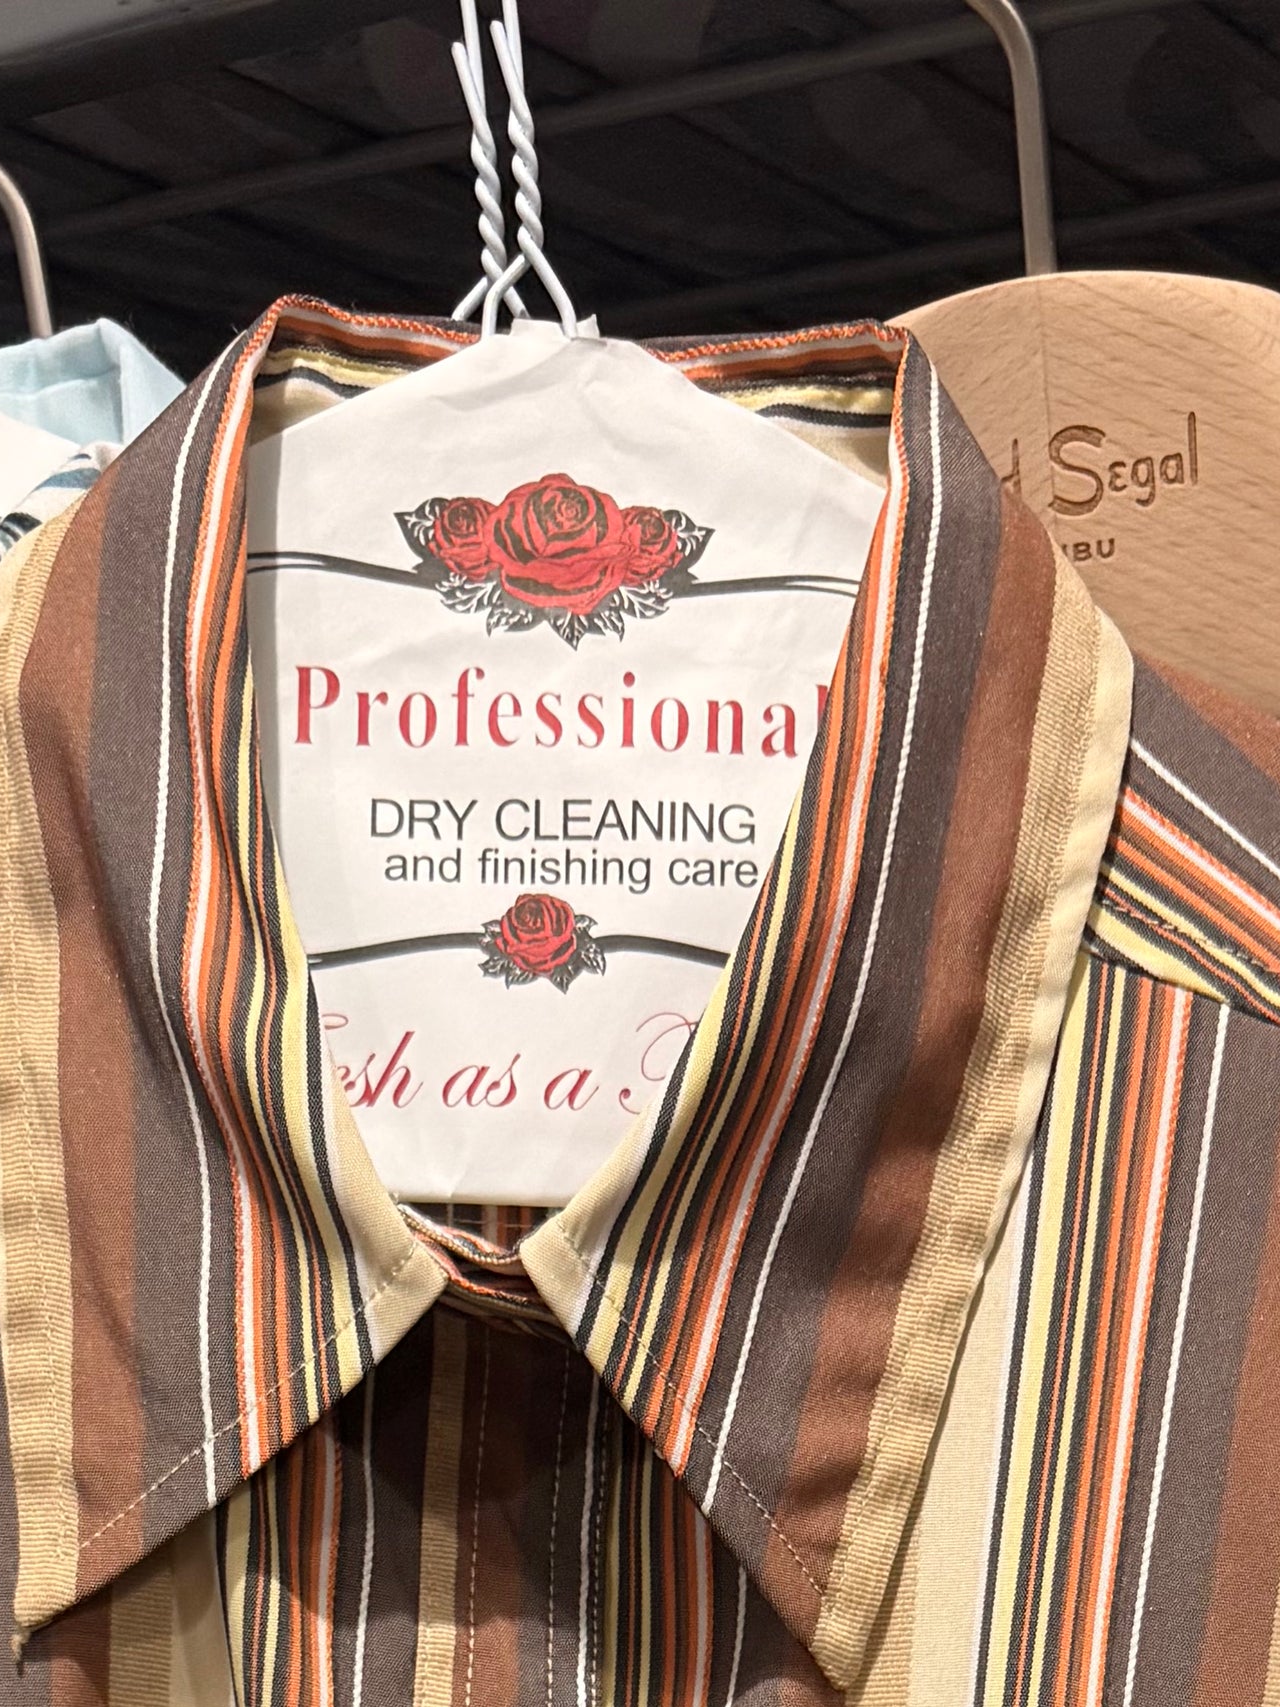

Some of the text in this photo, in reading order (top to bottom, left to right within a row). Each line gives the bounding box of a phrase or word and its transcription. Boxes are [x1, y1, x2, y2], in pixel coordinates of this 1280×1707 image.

[1047, 411, 1199, 518] Segal
[370, 797, 756, 845] DRY CLEANING
[384, 848, 759, 895] and finishing care
[441, 1053, 522, 1109] as
[543, 1067, 600, 1112] a
